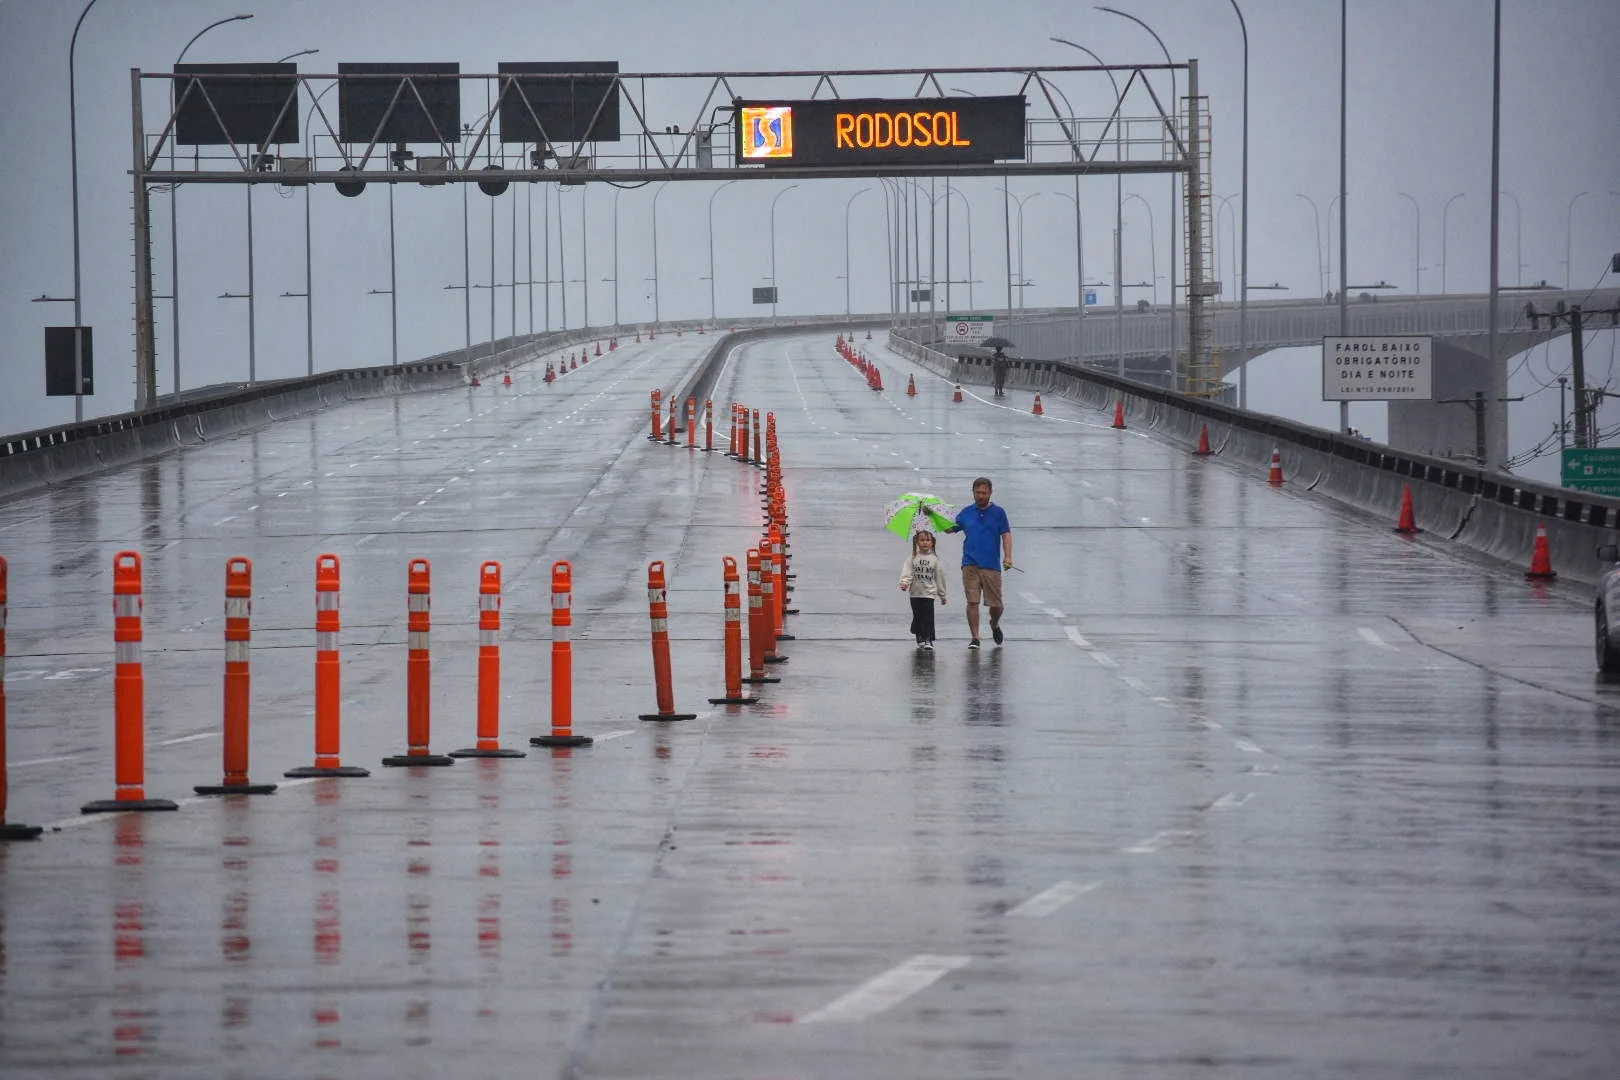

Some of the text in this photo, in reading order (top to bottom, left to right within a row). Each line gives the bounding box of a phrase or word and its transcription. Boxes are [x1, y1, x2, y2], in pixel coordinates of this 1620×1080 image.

[836, 111, 971, 149] RODOSOL
[1336, 343, 1420, 352] FAROL BAIXO
[1336, 354, 1420, 365] OBRIGATÓRIO
[1341, 370, 1415, 379] DIA E NOITE
